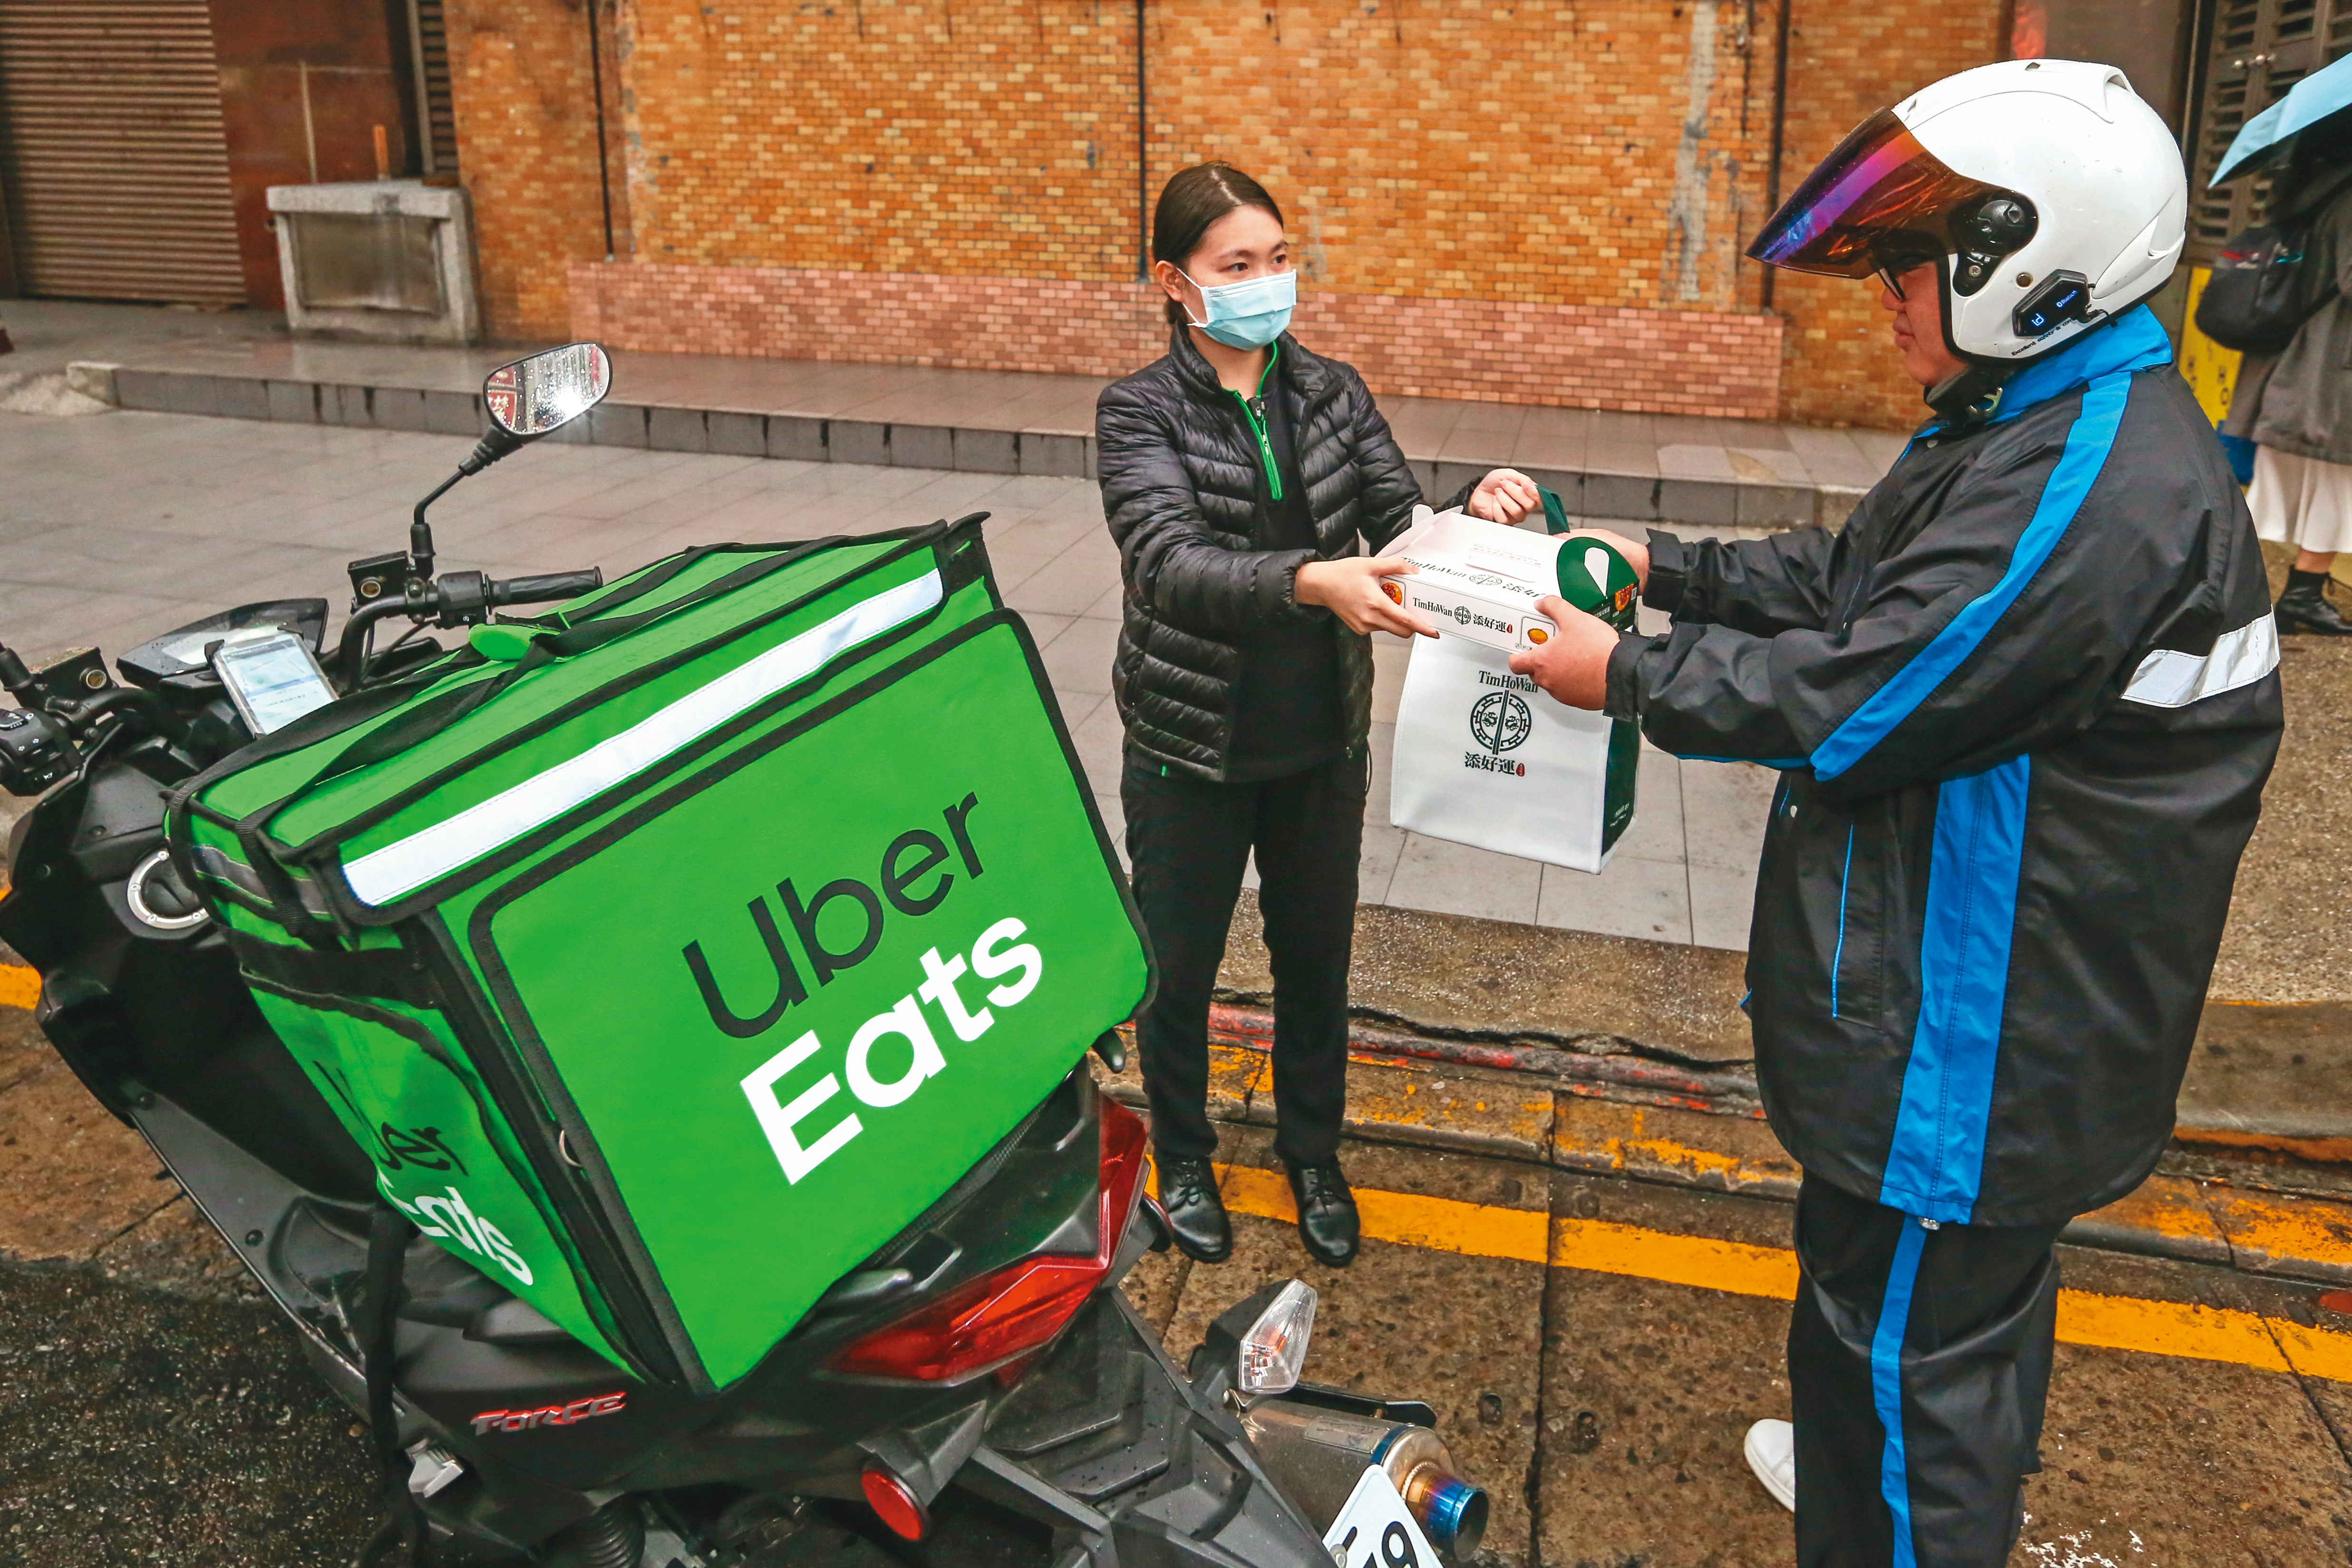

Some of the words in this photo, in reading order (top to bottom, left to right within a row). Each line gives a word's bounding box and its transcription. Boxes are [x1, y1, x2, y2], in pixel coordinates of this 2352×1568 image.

[2012, 341, 2036, 356] Excellent
[2037, 330, 2054, 342] safety
[1401, 556, 1467, 577] TimHoWan
[1502, 583, 1546, 598] 添好
[1413, 597, 1452, 617] TimHoWan
[1473, 614, 1506, 633] 添好運
[1478, 670, 1538, 693] TimHoWan
[1464, 751, 1516, 775] 添好運
[682, 791, 984, 1038] Uber
[739, 917, 1042, 1186] Eats
